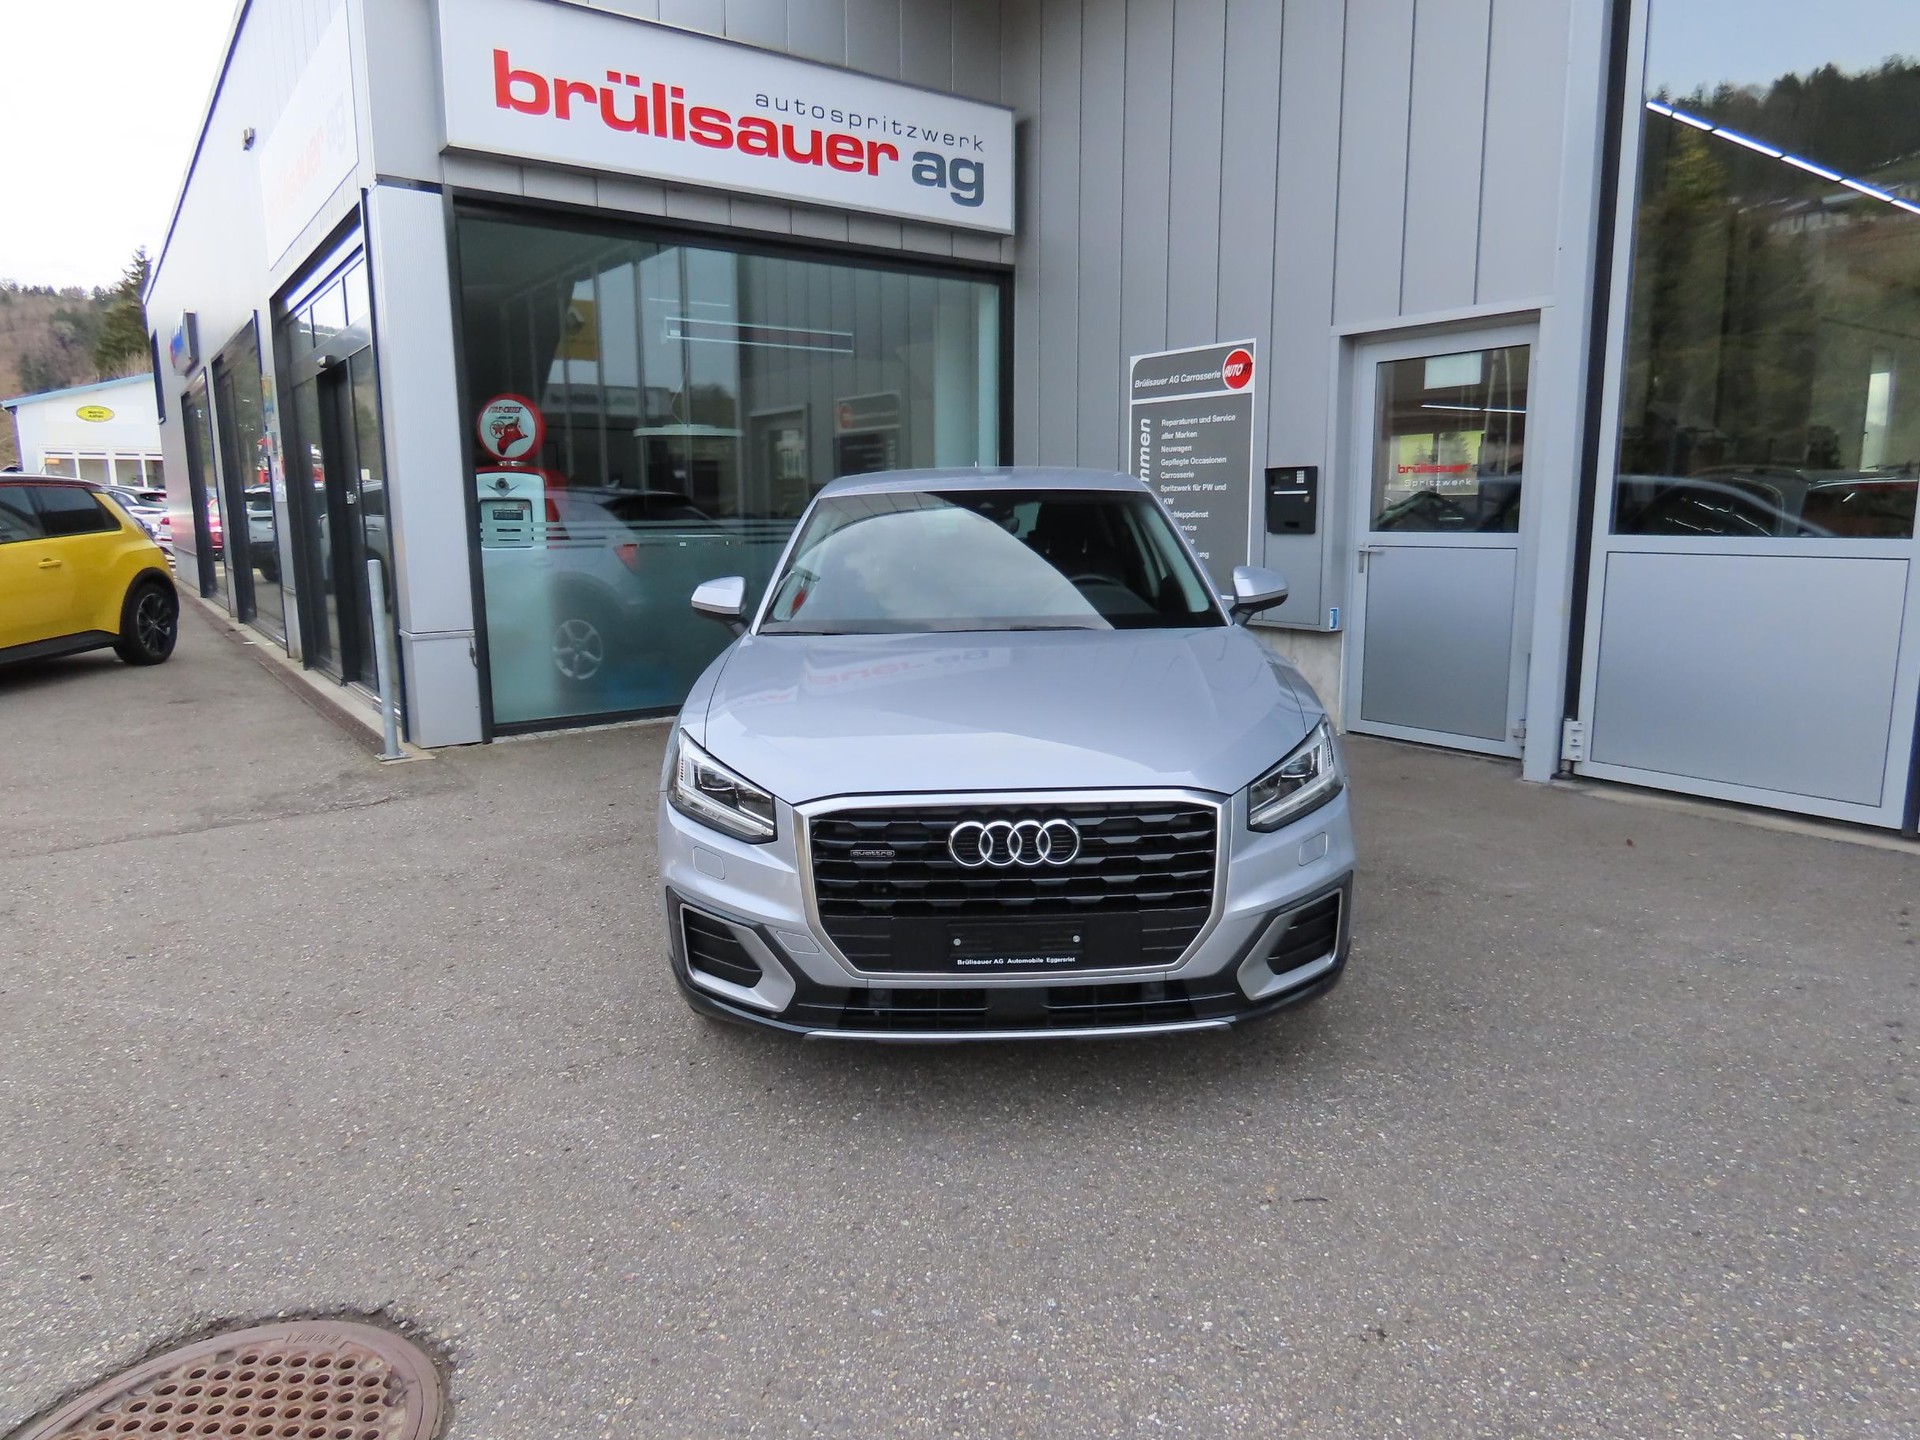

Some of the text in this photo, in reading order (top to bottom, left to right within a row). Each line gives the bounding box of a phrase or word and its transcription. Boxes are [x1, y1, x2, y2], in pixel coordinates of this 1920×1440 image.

[755, 92, 985, 153] autospritzwerk
[493, 48, 985, 208] brülisauer ag
[1134, 370, 1221, 388] Brülisauer AG Carrosserie
[1161, 413, 1236, 427] Reparaturen und Service
[1161, 430, 1198, 440] aller Marken
[1161, 445, 1192, 454] Neuwagen
[1160, 456, 1227, 467] Gepflegte Occasionen
[1160, 470, 1195, 479] Carrosserie
[1404, 478, 1472, 487] Spritzwerk
[1160, 483, 1227, 493] Spritzwerk für PW und
[957, 958, 992, 966] Brülisauer
